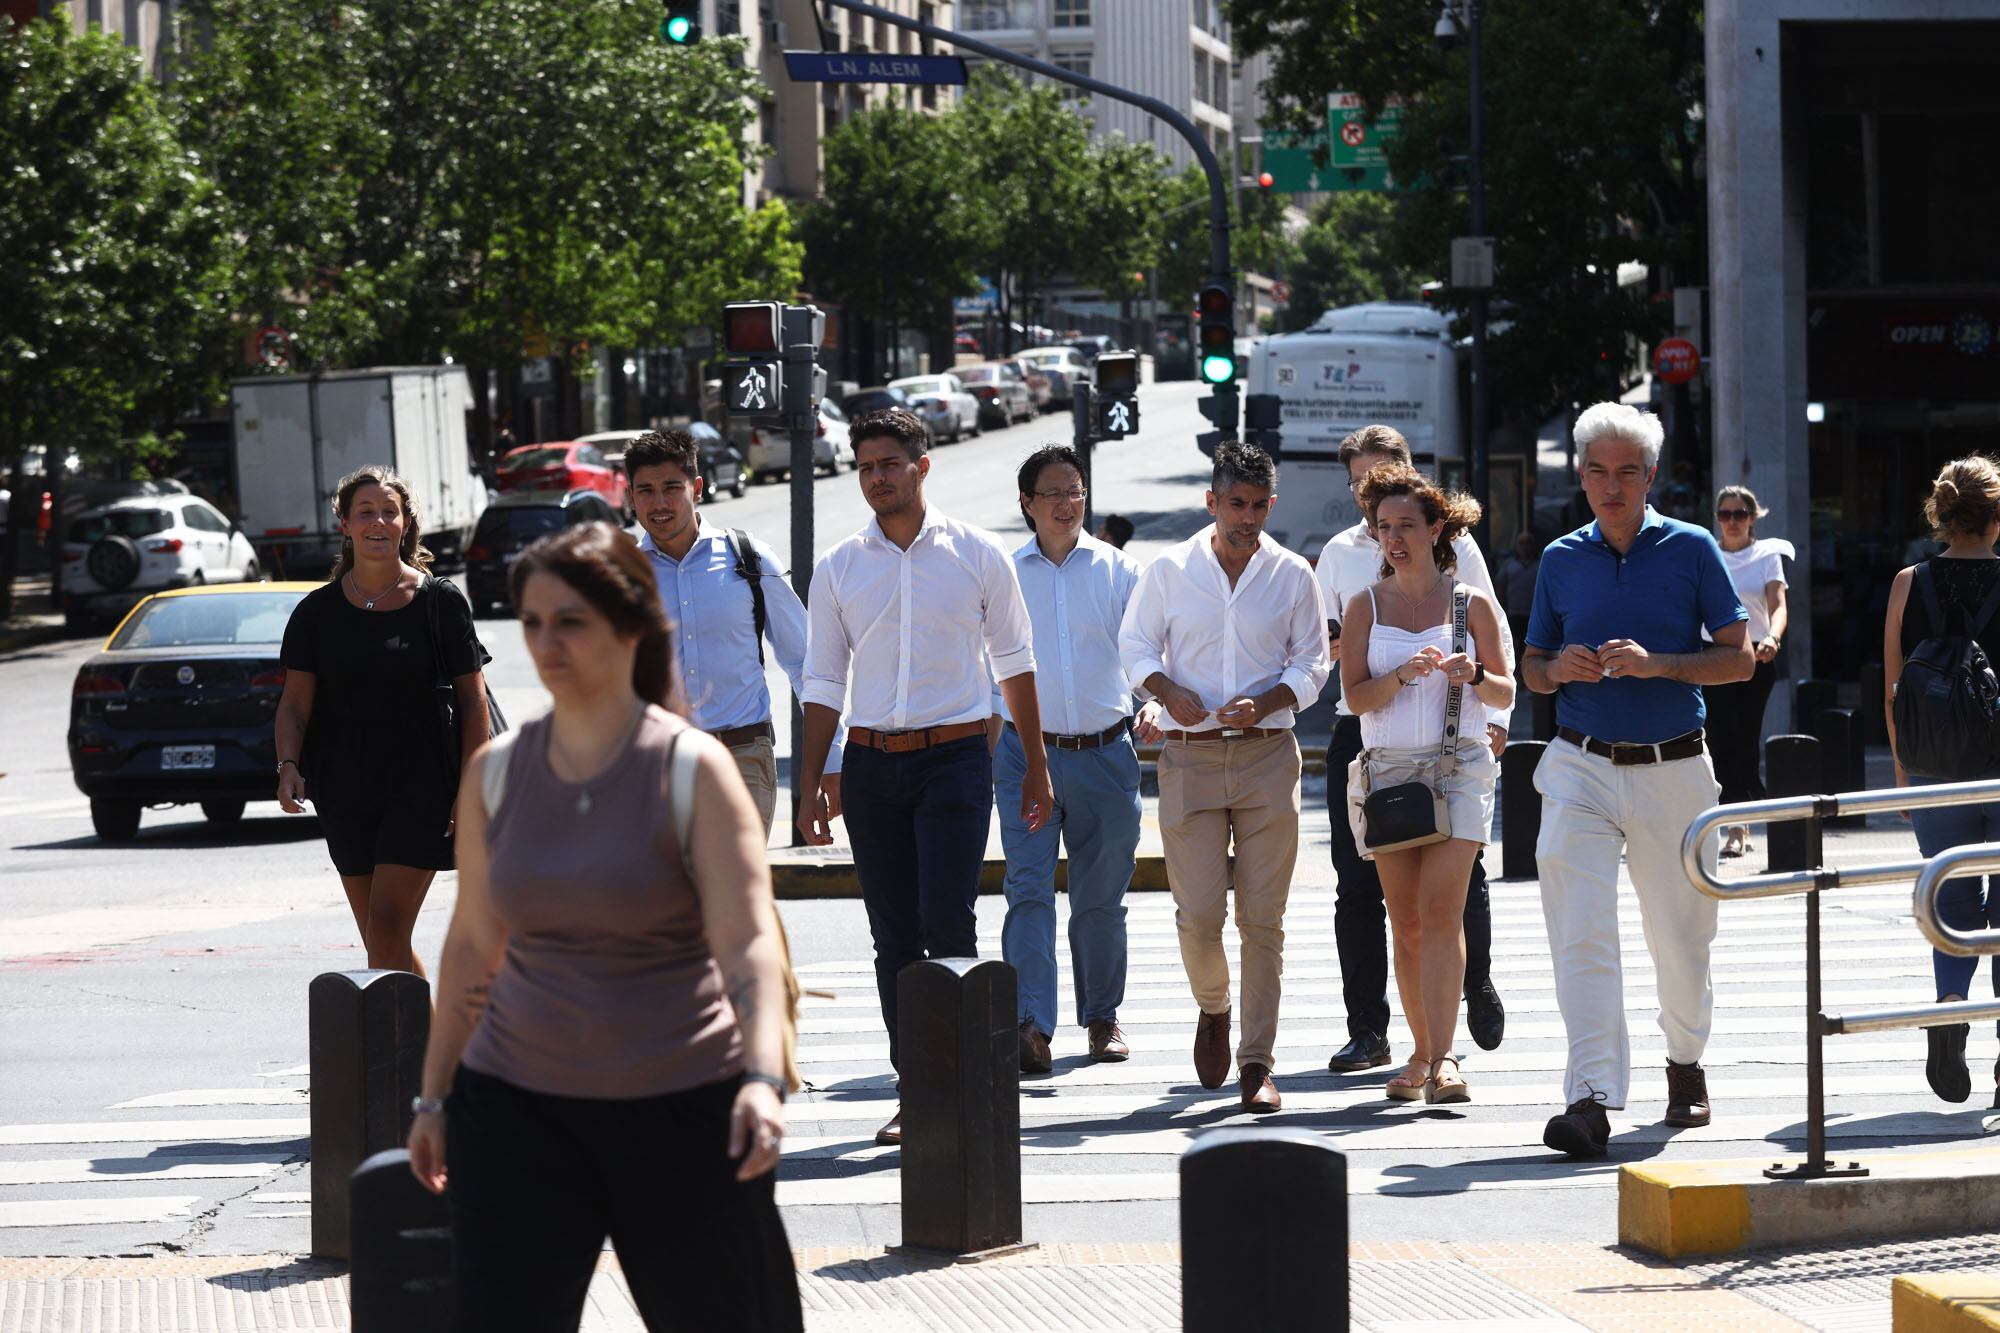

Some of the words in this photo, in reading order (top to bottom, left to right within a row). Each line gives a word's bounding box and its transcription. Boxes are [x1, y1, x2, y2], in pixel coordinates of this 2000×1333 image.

[827, 61, 863, 75] L.N.
[869, 62, 920, 77] ALEM
[1890, 326, 1945, 343] OPEN
[1454, 592, 1464, 607] LAS
[1454, 609, 1465, 639] OREIRO
[1447, 685, 1460, 717] OREIRO
